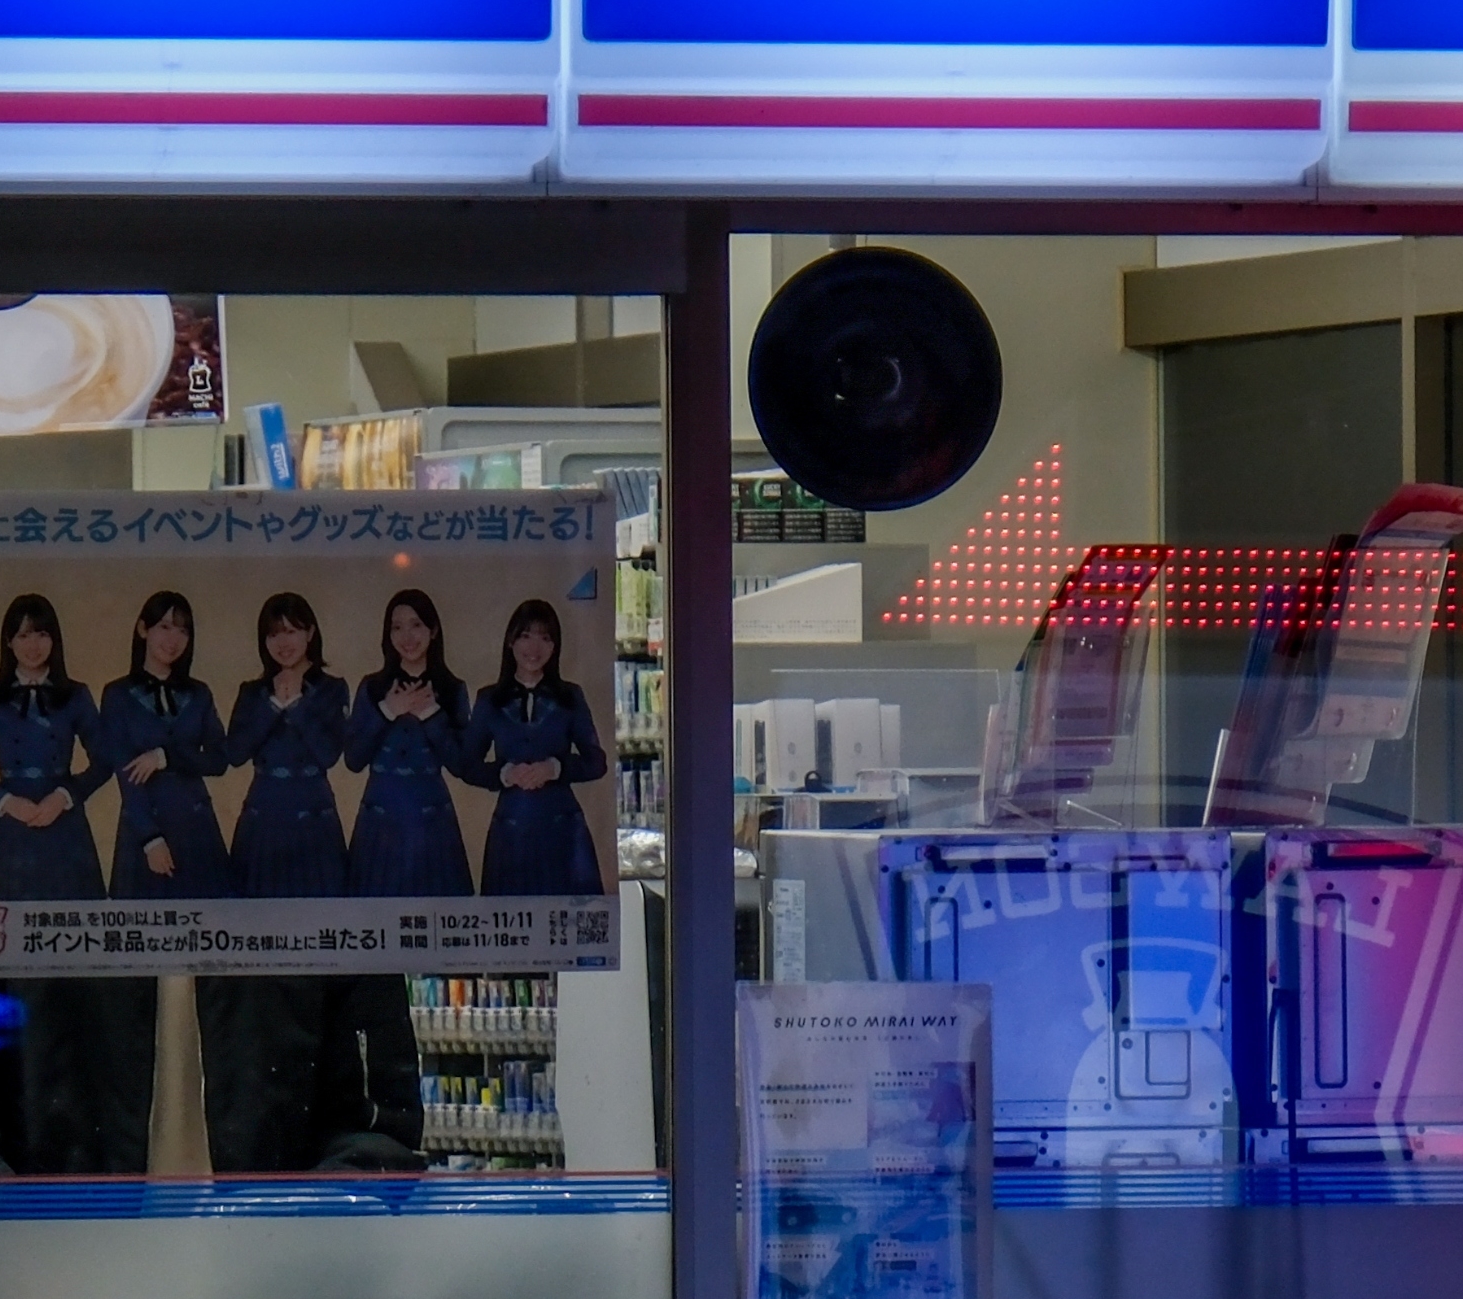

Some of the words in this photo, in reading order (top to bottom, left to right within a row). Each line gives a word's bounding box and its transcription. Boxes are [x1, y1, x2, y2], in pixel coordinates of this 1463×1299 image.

[24, 911, 81, 926] 対象商品
[400, 915, 428, 929] 実施
[400, 935, 428, 948] 期間
[774, 1016, 858, 1029] SHUTOKO
[863, 1016, 915, 1028] MIRAI
[921, 1015, 957, 1028] WAY
